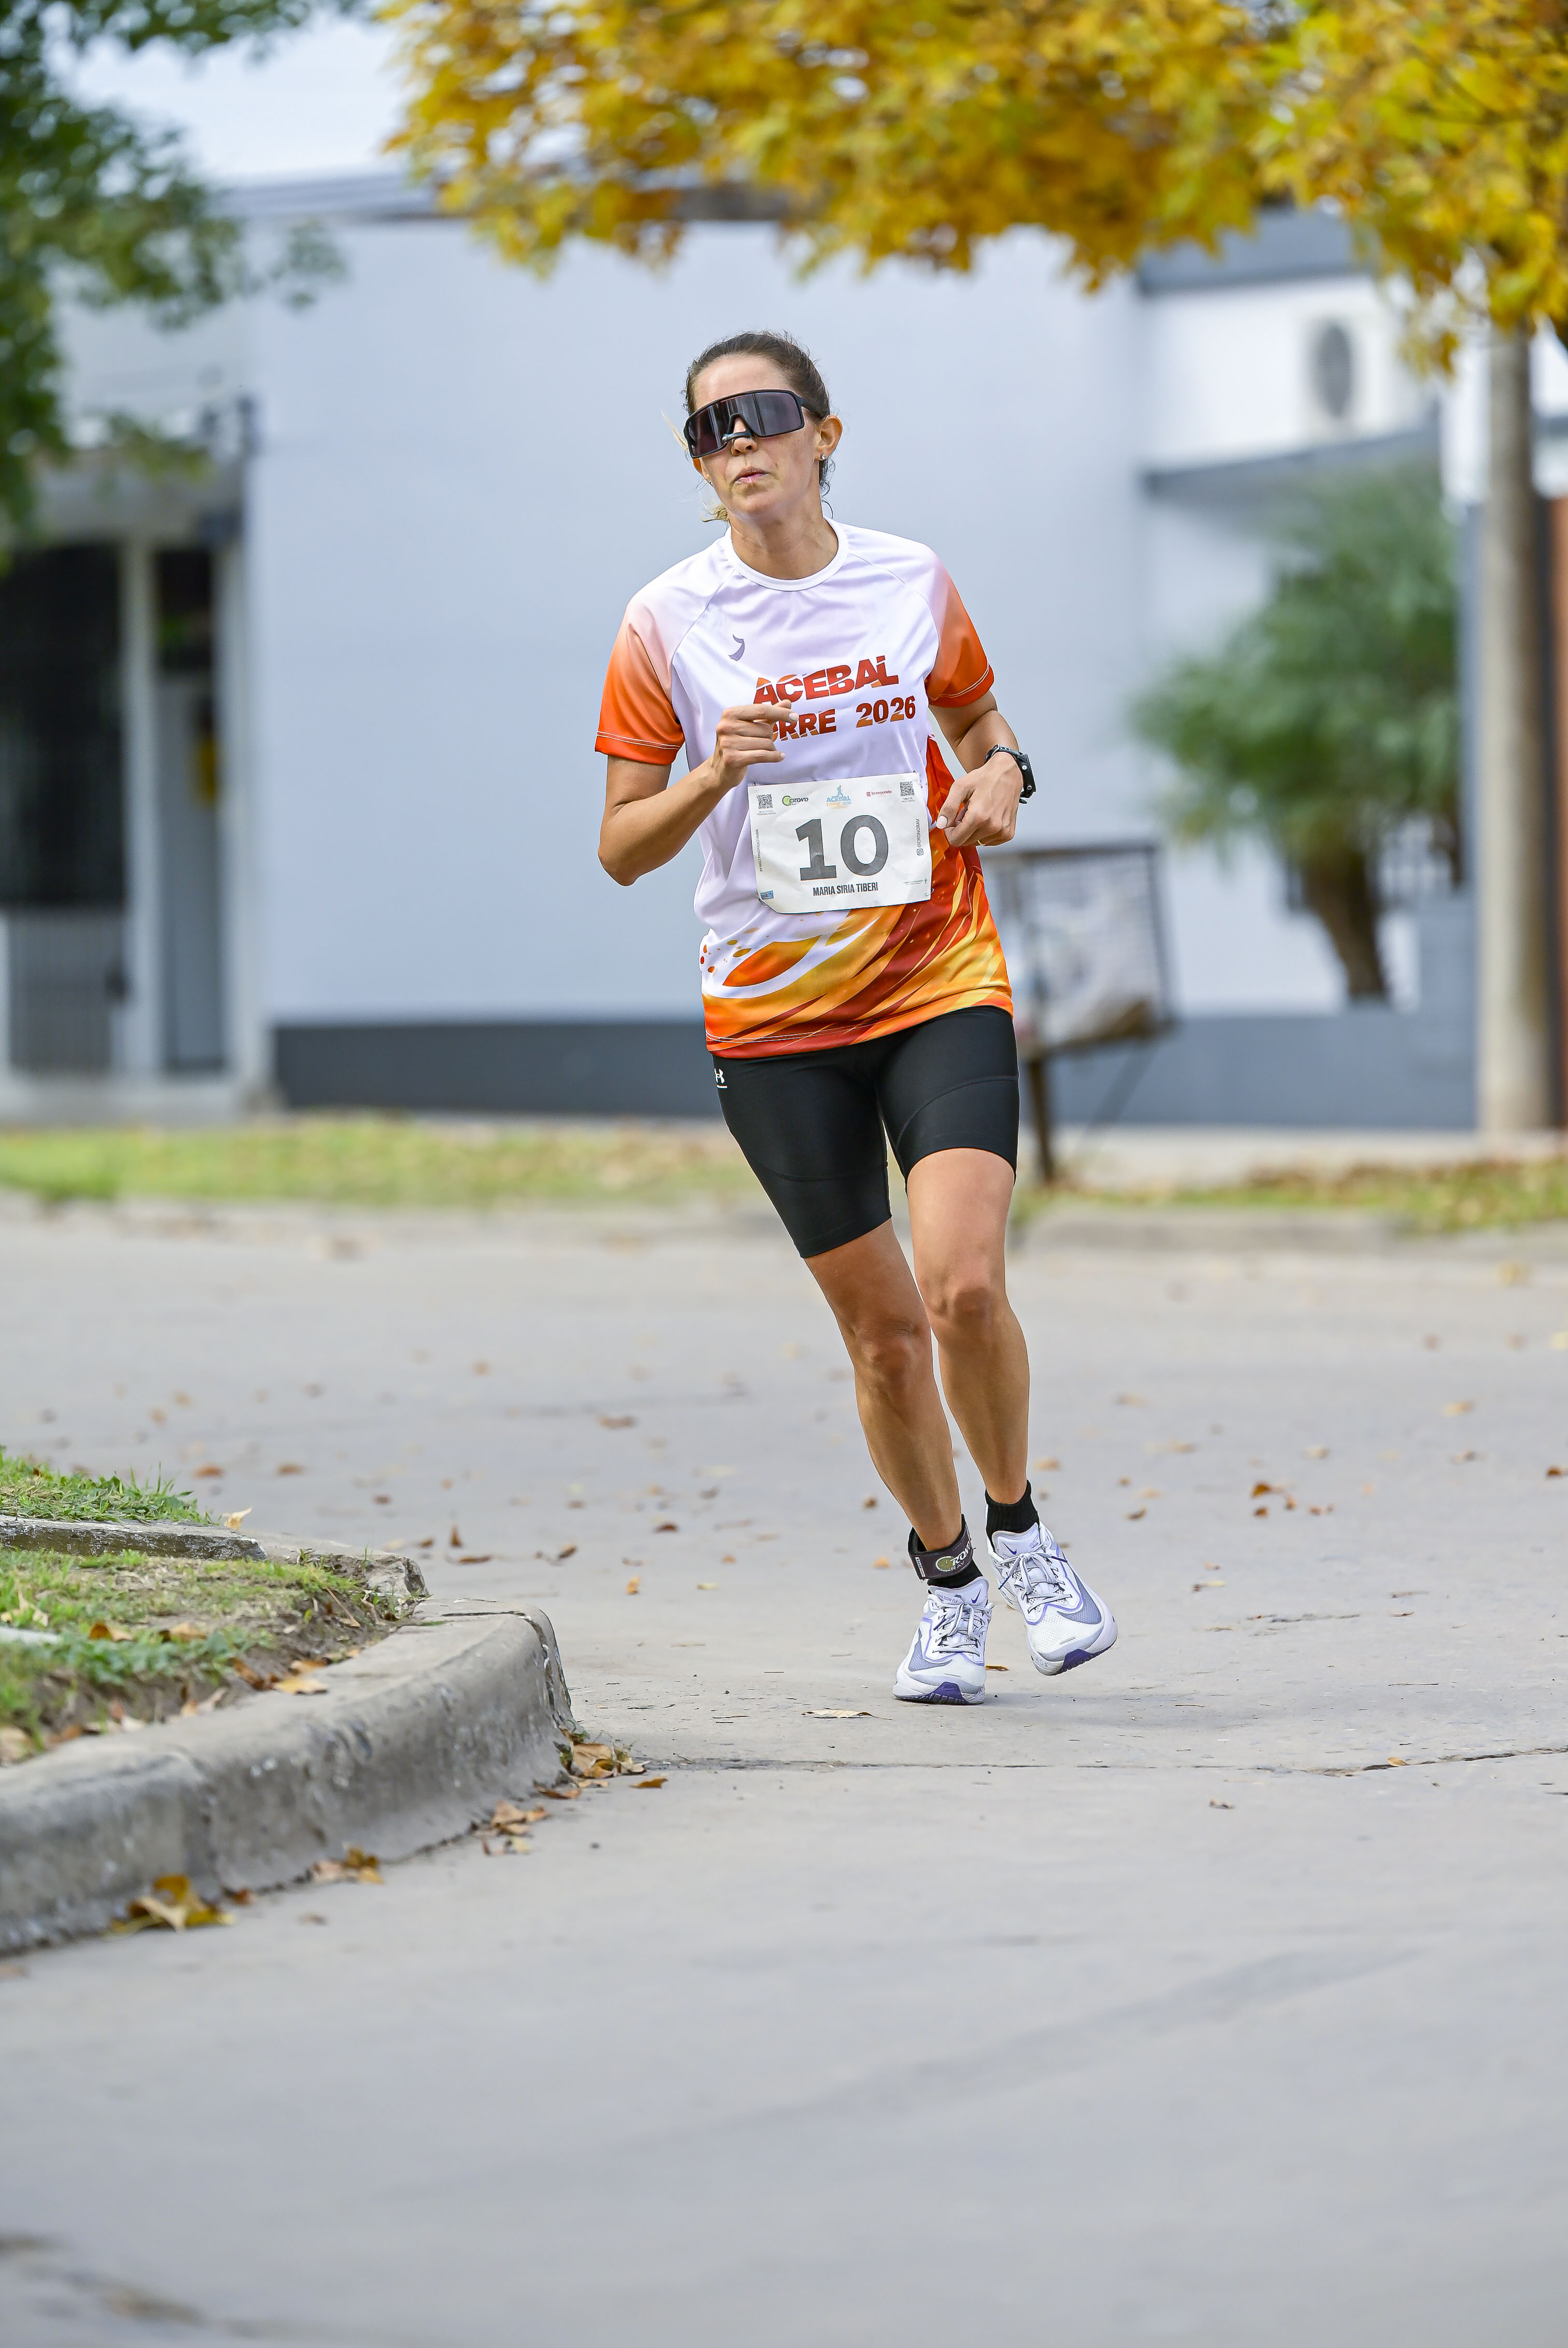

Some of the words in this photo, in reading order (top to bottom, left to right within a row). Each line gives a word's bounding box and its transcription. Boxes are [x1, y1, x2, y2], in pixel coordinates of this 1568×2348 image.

[753, 655, 899, 705] ACEBAL
[856, 695, 916, 728] 2026
[795, 815, 889, 881] 10
[813, 886, 835, 896] MARIA
[836, 884, 855, 894] SIRIA
[856, 882, 878, 892] TIBERI
